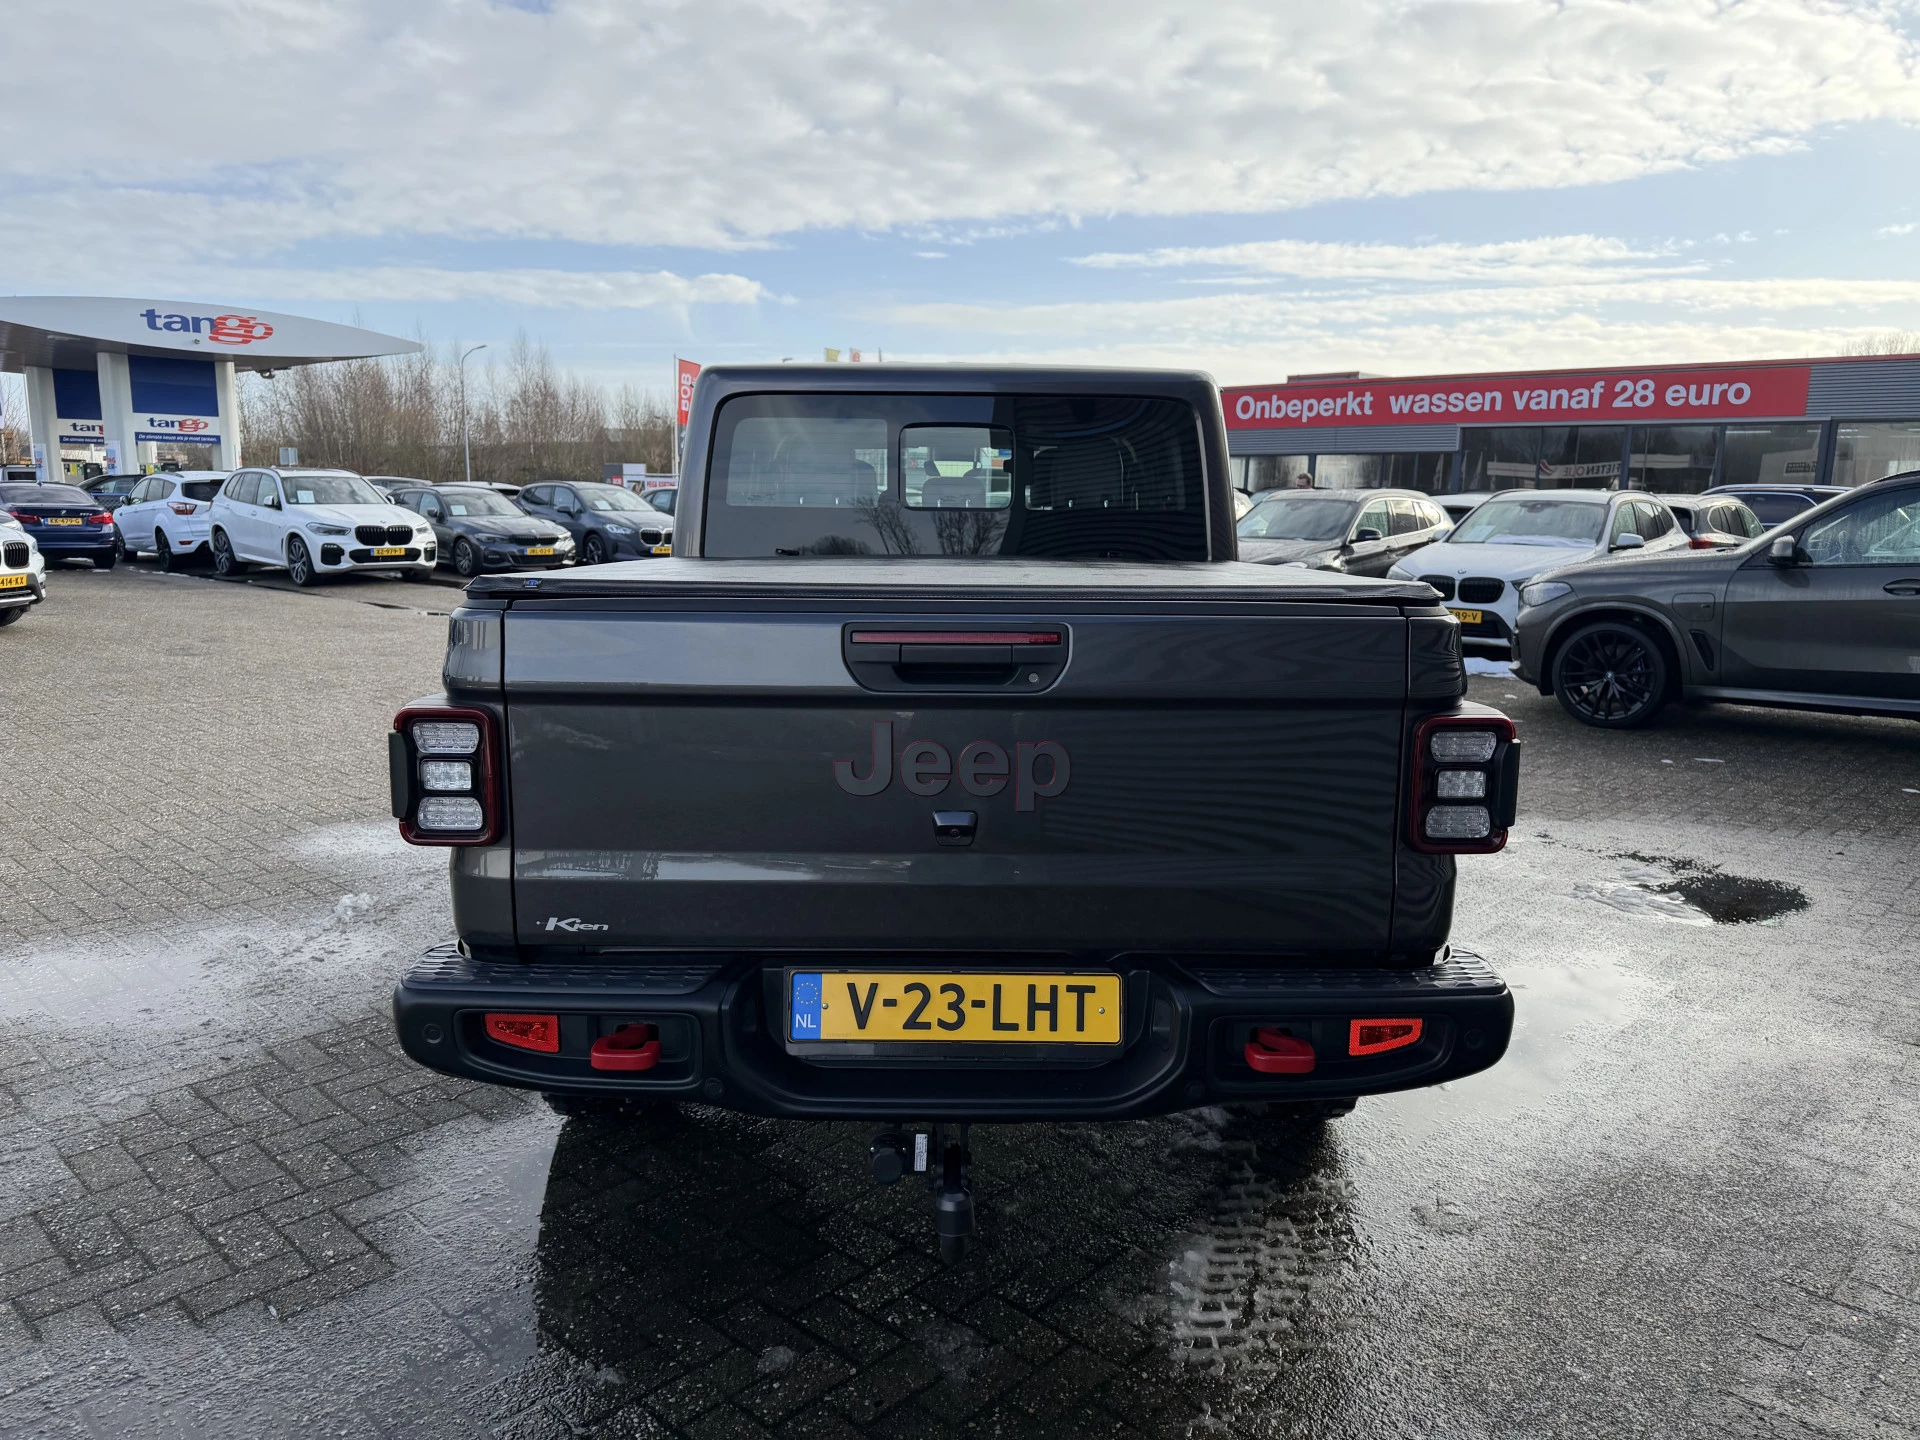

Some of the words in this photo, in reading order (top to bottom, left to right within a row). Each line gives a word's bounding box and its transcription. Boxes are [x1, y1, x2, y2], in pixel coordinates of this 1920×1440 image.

[140, 309, 274, 345] tango
[680, 372, 692, 411] BOB
[1235, 391, 1373, 422] Onbeperkt
[1389, 390, 1502, 415] wassen
[1512, 381, 1605, 411] vanaf
[1612, 379, 1655, 408] 28
[1664, 381, 1751, 407] euro
[70, 422, 104, 435] tan
[147, 417, 209, 432] tango
[1449, 610, 1478, 621] 89-V
[832, 720, 1072, 812] Jeep
[545, 917, 609, 932] Kien
[846, 982, 1097, 1032] V-23-LHT
[795, 1013, 817, 1029] NL
